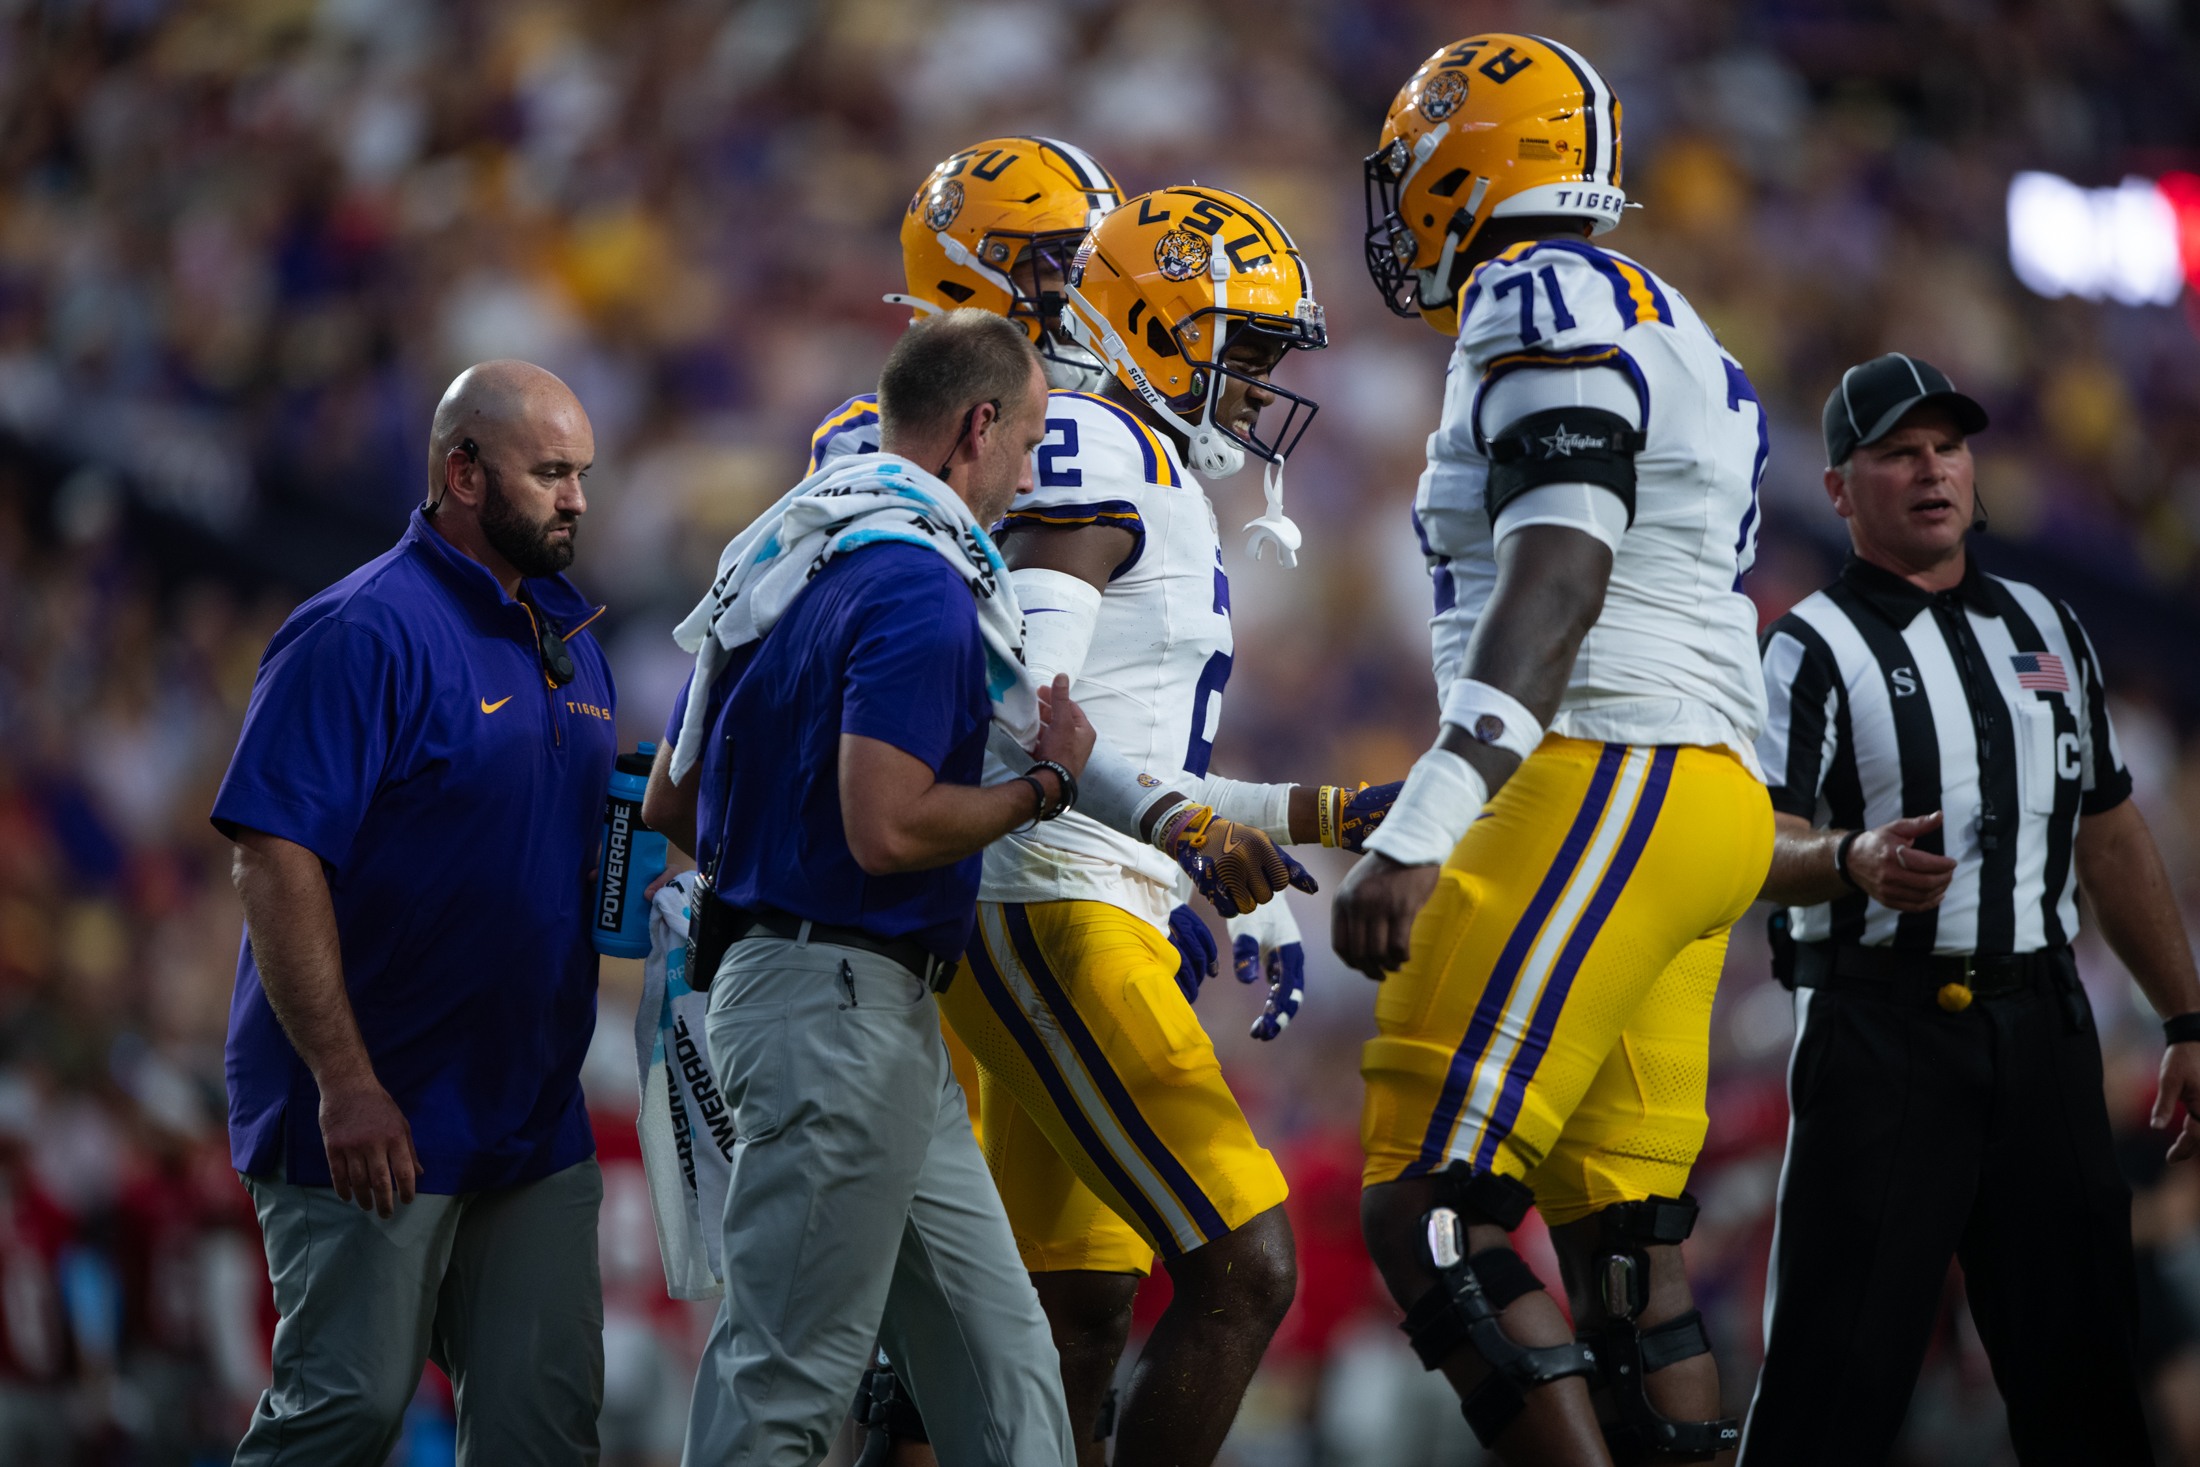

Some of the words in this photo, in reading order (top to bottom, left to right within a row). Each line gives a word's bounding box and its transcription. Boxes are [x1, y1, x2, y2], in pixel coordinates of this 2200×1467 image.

[1573, 147, 1583, 166] 7
[1137, 198, 1273, 275] LSU
[1492, 263, 1577, 347] 71
[1127, 366, 1159, 405] schutt
[1037, 417, 1083, 488] 2
[566, 701, 613, 721] TIGERS
[2056, 732, 2081, 781] C
[1341, 817, 1363, 832] LSU
[1368, 810, 1386, 820] LSU
[601, 803, 631, 929] POWERADE
